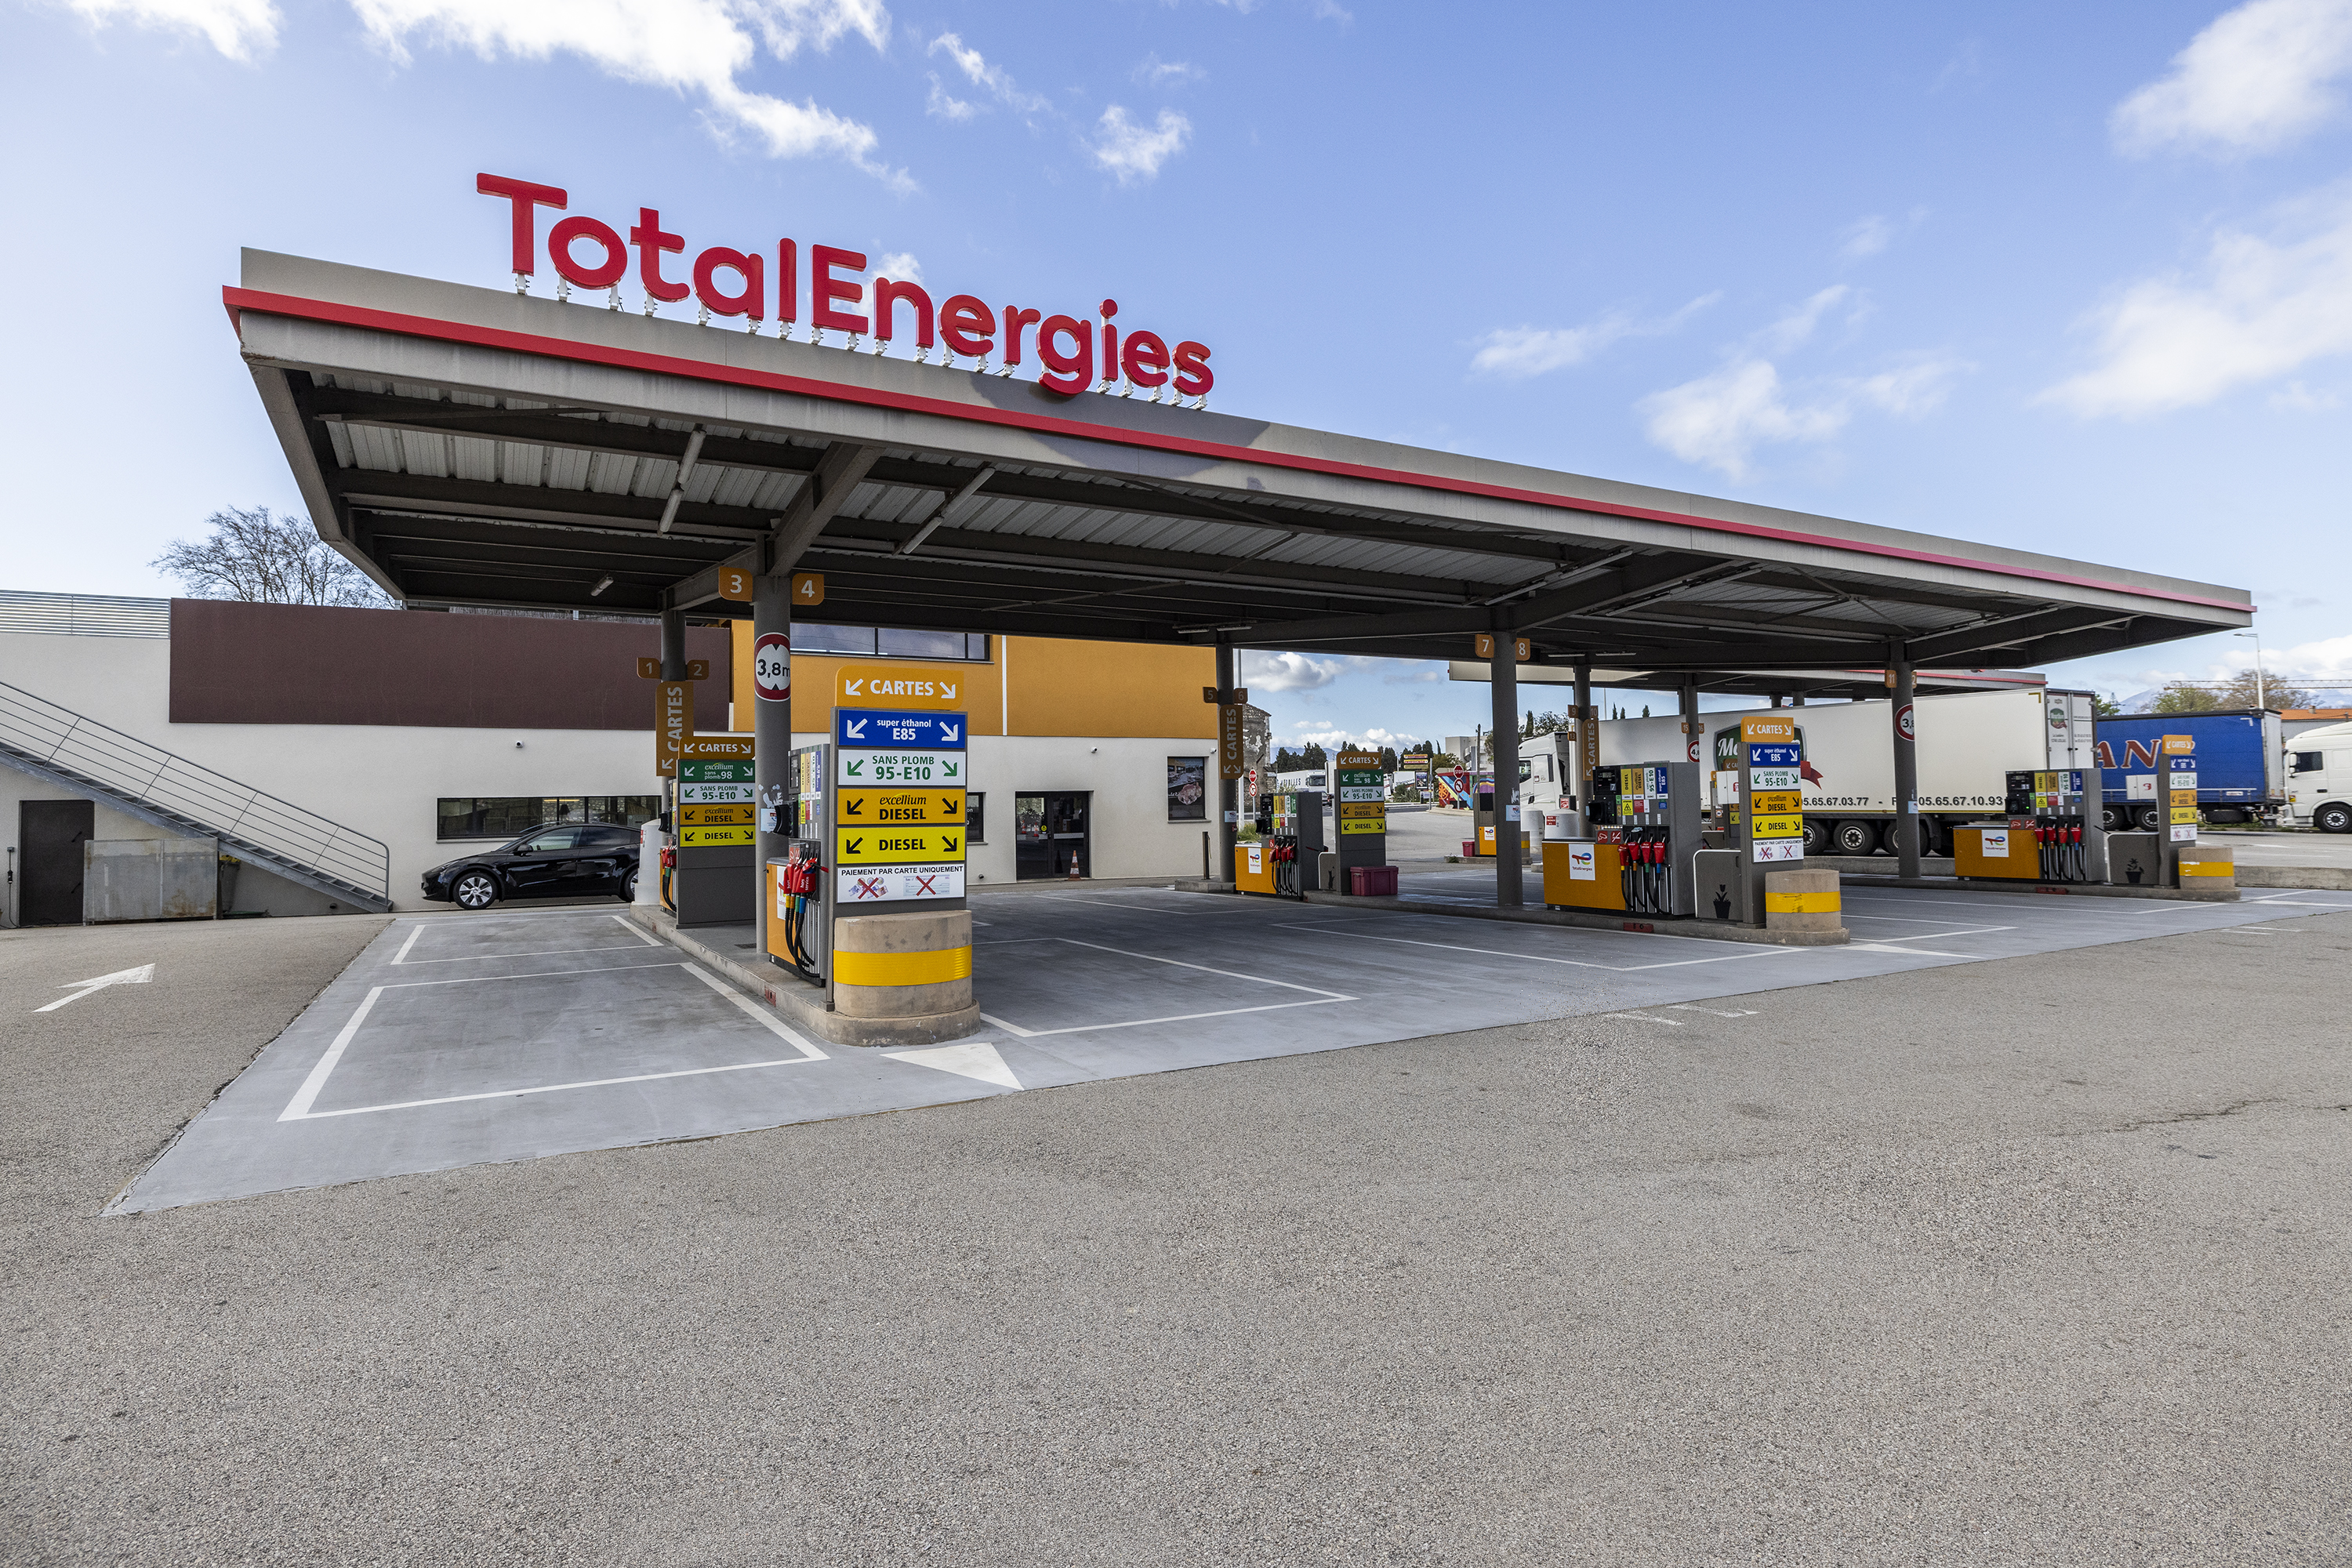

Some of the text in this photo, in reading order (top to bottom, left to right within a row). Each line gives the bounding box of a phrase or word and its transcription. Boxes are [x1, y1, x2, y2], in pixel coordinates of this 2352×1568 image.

[476, 172, 1214, 396] TotalEnergies
[730, 574, 742, 593] 3
[801, 579, 815, 597] 4
[1482, 639, 1490, 652] 7
[1519, 642, 1526, 655] 8
[646, 662, 652, 674] 1
[694, 664, 702, 676] 2
[1889, 673, 1895, 684] 11
[869, 680, 935, 696] CARTES
[1207, 690, 1214, 700] 5
[1238, 691, 1244, 700] 6
[1572, 707, 1577, 716] 9
[1591, 708, 1598, 717] 10
[667, 686, 683, 752] CARTES
[877, 719, 931, 728] super éthanol
[892, 728, 916, 740] E85
[1226, 708, 1237, 760] CARTES
[1757, 724, 1783, 735] CARTES
[699, 743, 738, 753] CARTES
[872, 755, 935, 764] SANS PLOMB
[720, 771, 732, 779] 98
[875, 766, 931, 780] 95-E10
[1766, 777, 1788, 786] 95-E10
[880, 794, 927, 805] excellium
[1802, 797, 1869, 806] 5.65.67.03.77
[1918, 796, 2003, 806] 05.65.67.10.93
[880, 808, 926, 820] DIESEL
[879, 839, 926, 851] DIESEL
